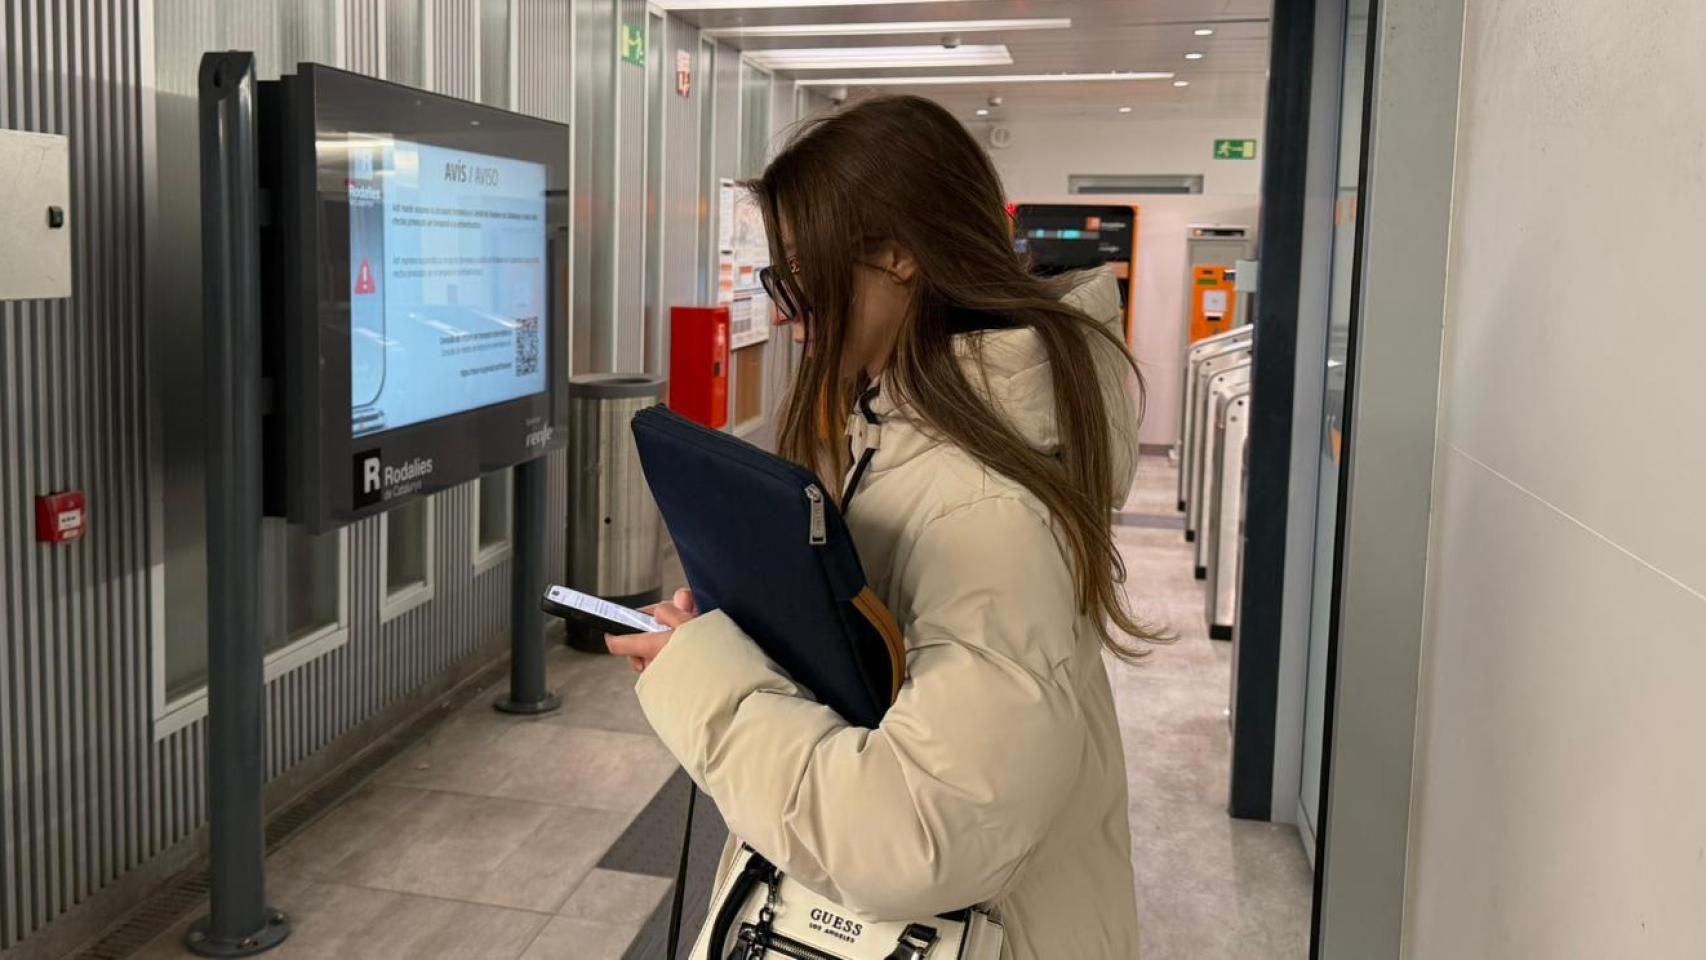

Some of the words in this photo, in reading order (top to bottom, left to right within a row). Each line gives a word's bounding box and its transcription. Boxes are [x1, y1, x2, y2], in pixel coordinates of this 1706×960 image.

[475, 166, 499, 186] AVISO
[364, 457, 380, 494] R
[384, 458, 433, 486] Rodalies
[809, 923, 822, 931] LOS
[824, 929, 855, 943] ANGELES
[810, 908, 863, 936] GUESS
